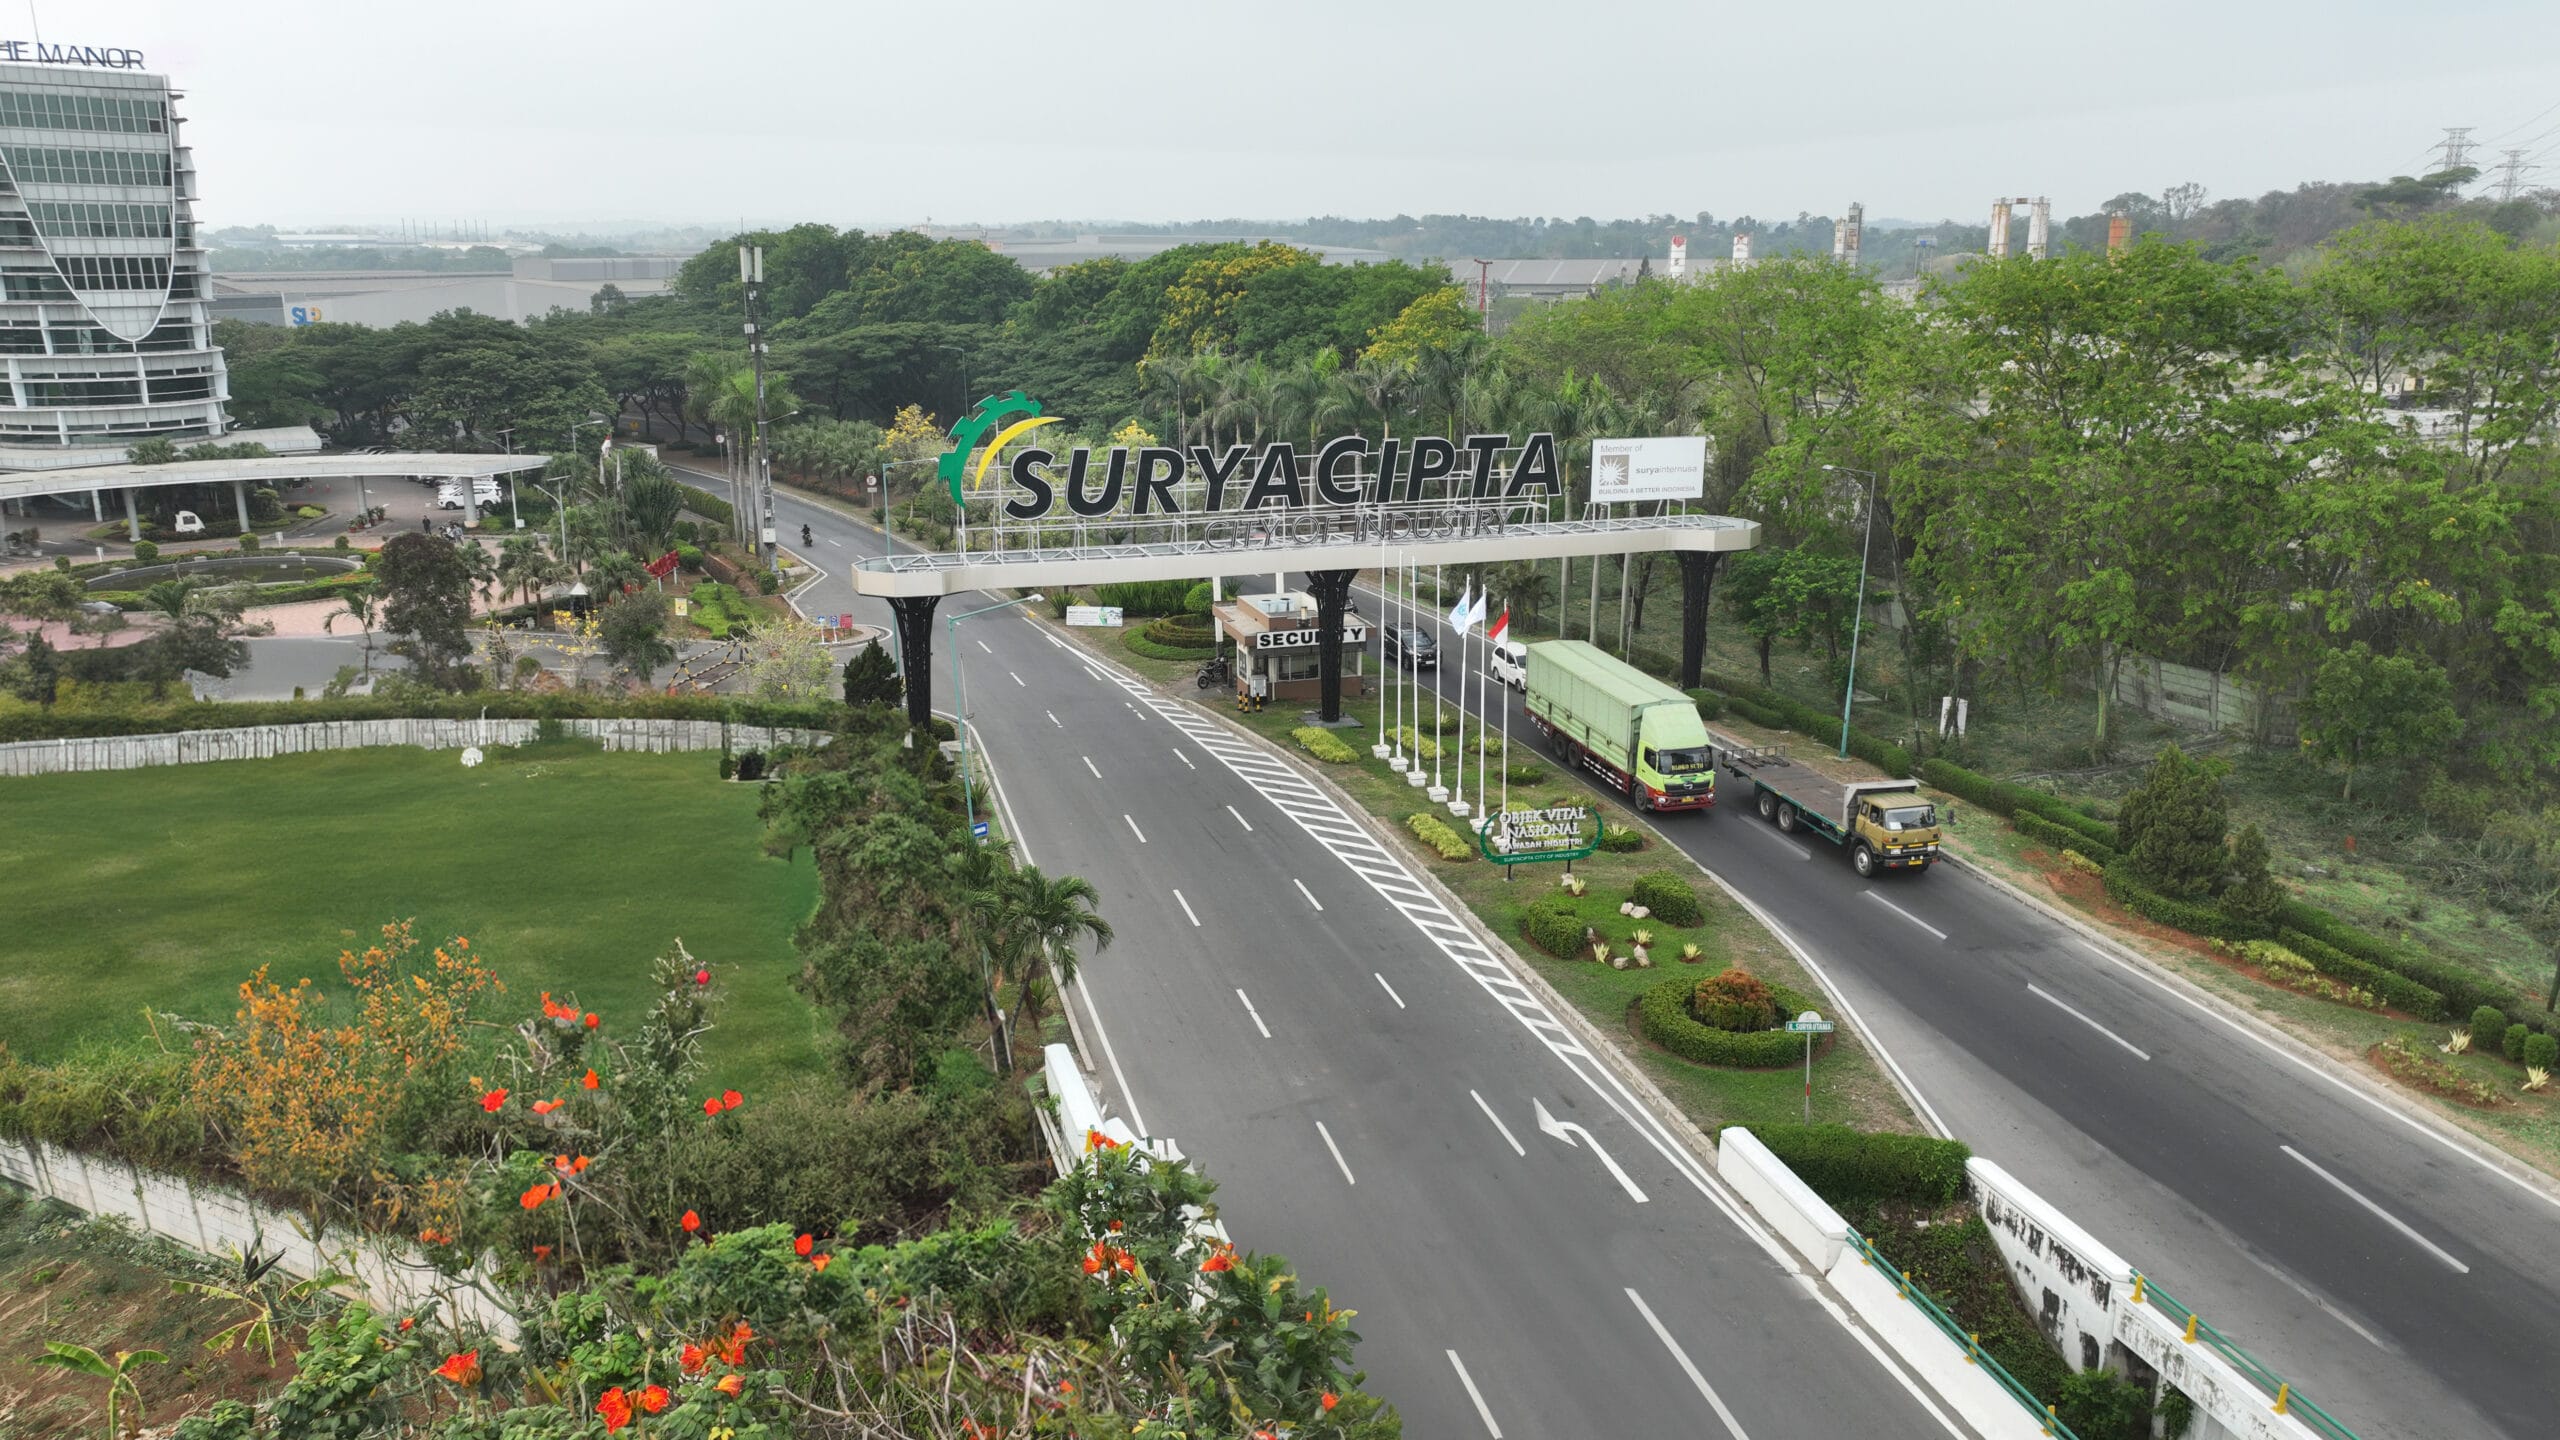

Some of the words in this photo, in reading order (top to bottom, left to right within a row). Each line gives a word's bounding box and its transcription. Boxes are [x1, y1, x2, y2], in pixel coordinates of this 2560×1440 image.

[38, 43, 146, 70] MANOR
[1635, 444, 1642, 452] of
[1004, 432, 1563, 521] SURYACIPTA
[1661, 485, 1695, 493] INDONESIA
[1203, 517, 1281, 549] CITY
[1292, 515, 1341, 544] OF
[1352, 506, 1515, 543] INDUSTRY
[1499, 810, 1545, 825] OBJEK
[1546, 807, 1586, 820] VITAL
[1507, 822, 1580, 838] NASIONAL
[1544, 838, 1583, 847] INDUSTRI
